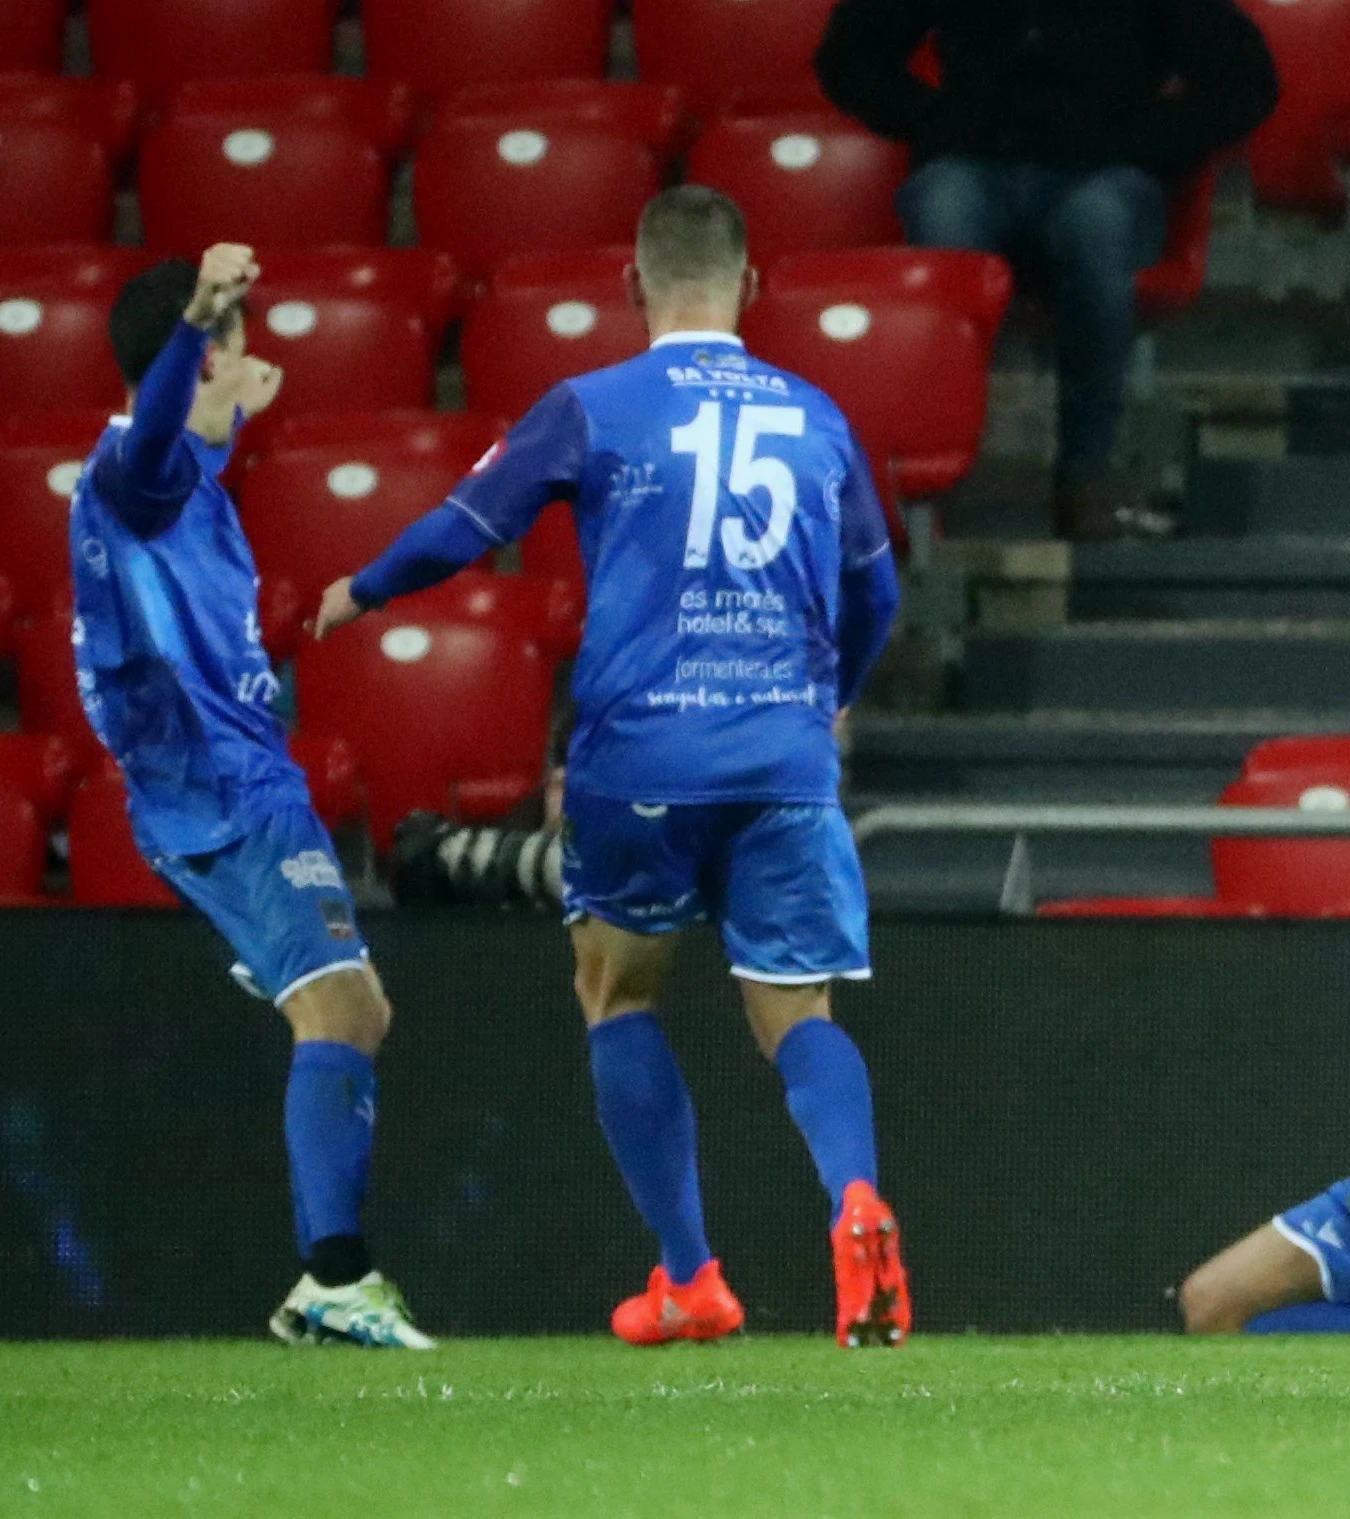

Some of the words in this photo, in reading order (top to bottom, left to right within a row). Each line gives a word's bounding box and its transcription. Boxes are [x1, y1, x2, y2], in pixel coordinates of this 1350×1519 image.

[666, 366, 703, 382] SA
[670, 400, 806, 570] 15
[679, 589, 707, 609] es
